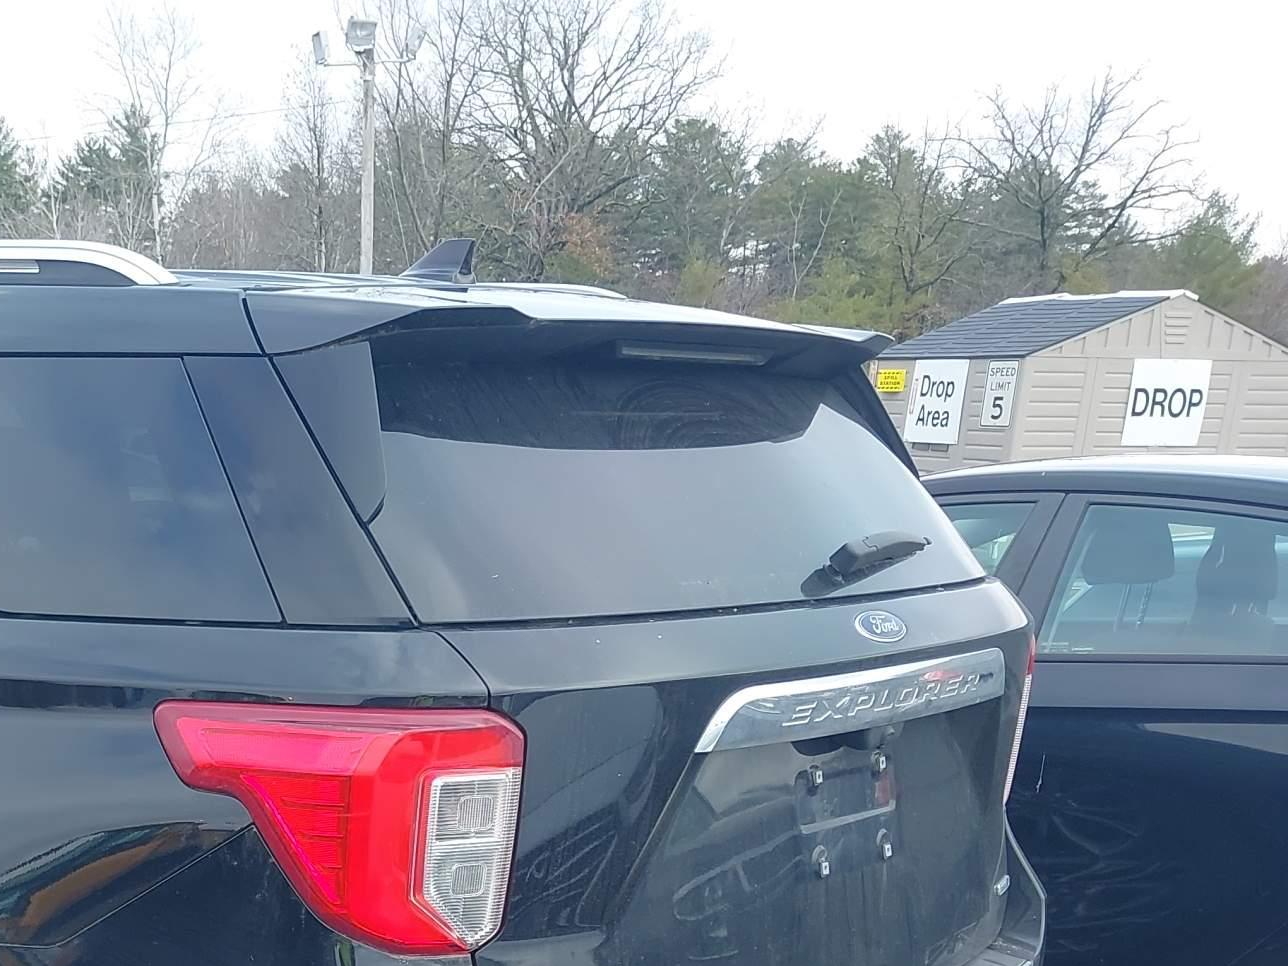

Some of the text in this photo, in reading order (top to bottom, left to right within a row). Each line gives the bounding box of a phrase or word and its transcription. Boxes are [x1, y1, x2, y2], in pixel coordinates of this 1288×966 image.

[990, 367, 1016, 377] SPEED
[920, 375, 955, 402] Drop
[990, 381, 1011, 391] LIMIT
[990, 396, 1004, 420] 5
[1131, 387, 1204, 419] DROP
[915, 404, 950, 427] Area
[782, 674, 981, 727] EXPLORER
